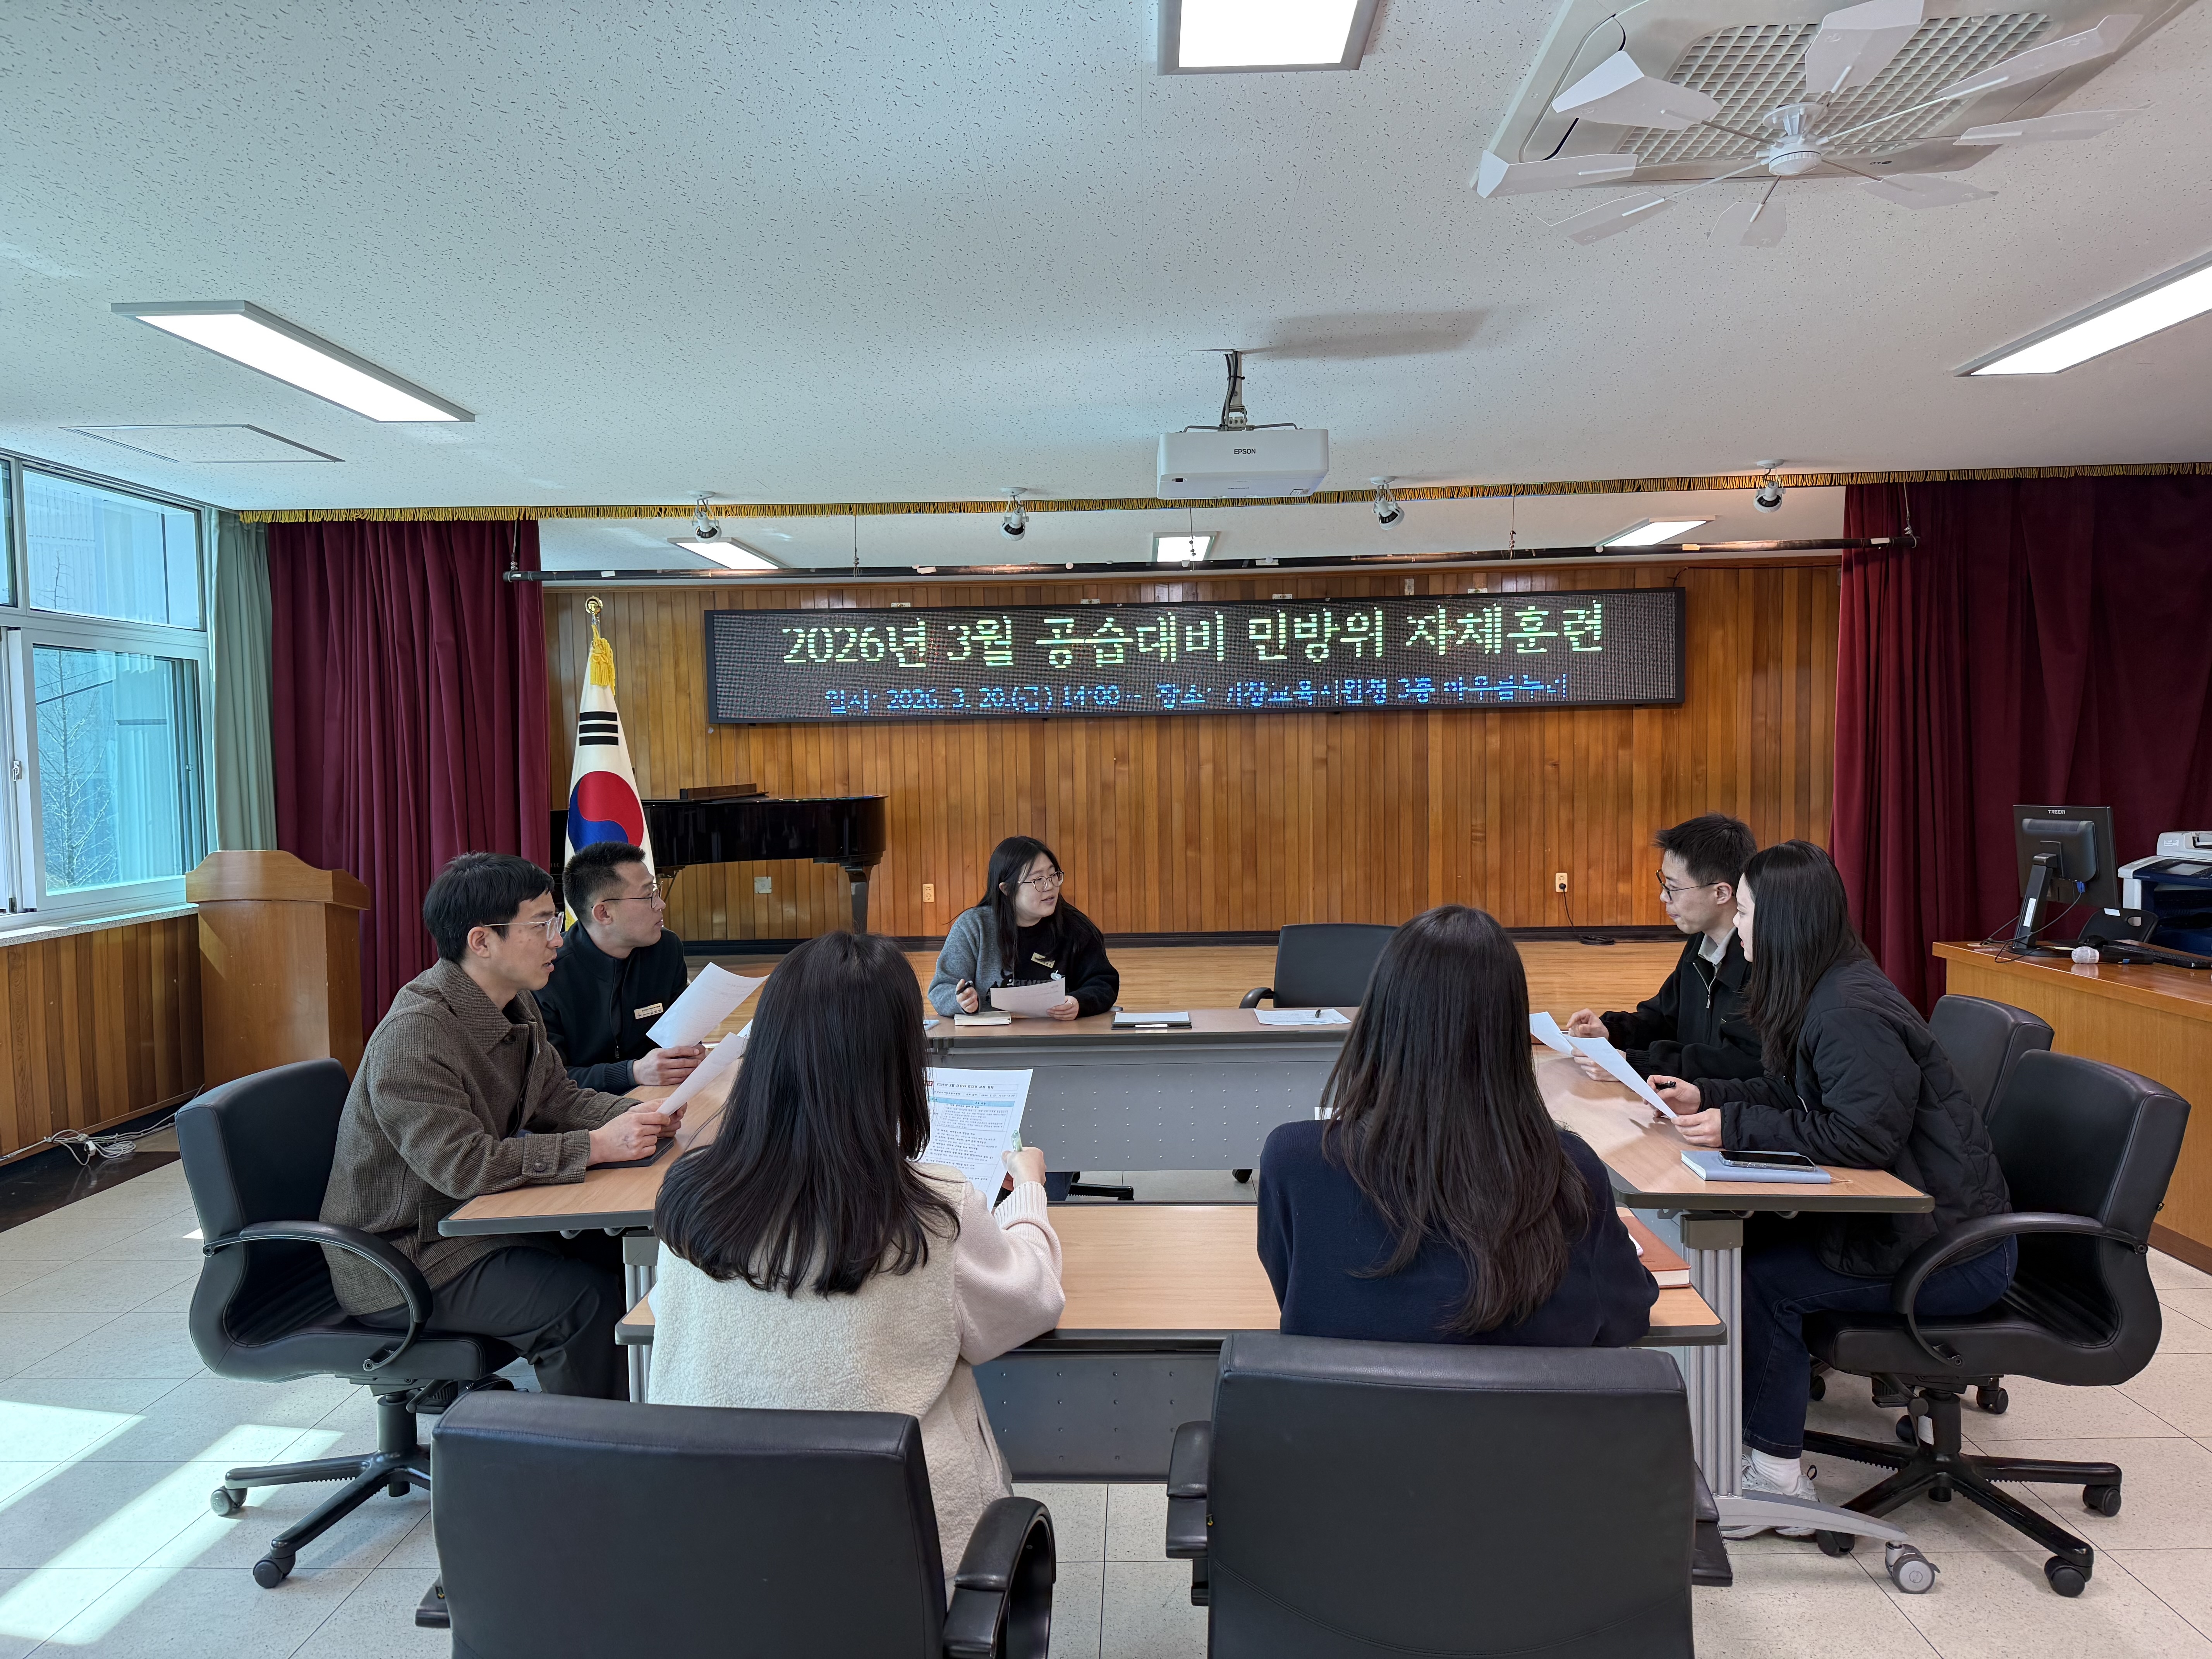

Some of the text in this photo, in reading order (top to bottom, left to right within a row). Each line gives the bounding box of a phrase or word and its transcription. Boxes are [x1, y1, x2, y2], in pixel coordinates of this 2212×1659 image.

[782, 599, 1603, 669] 2026년 3월 공습대비 민방위 자체훈련
[951, 688, 971, 708] 3.
